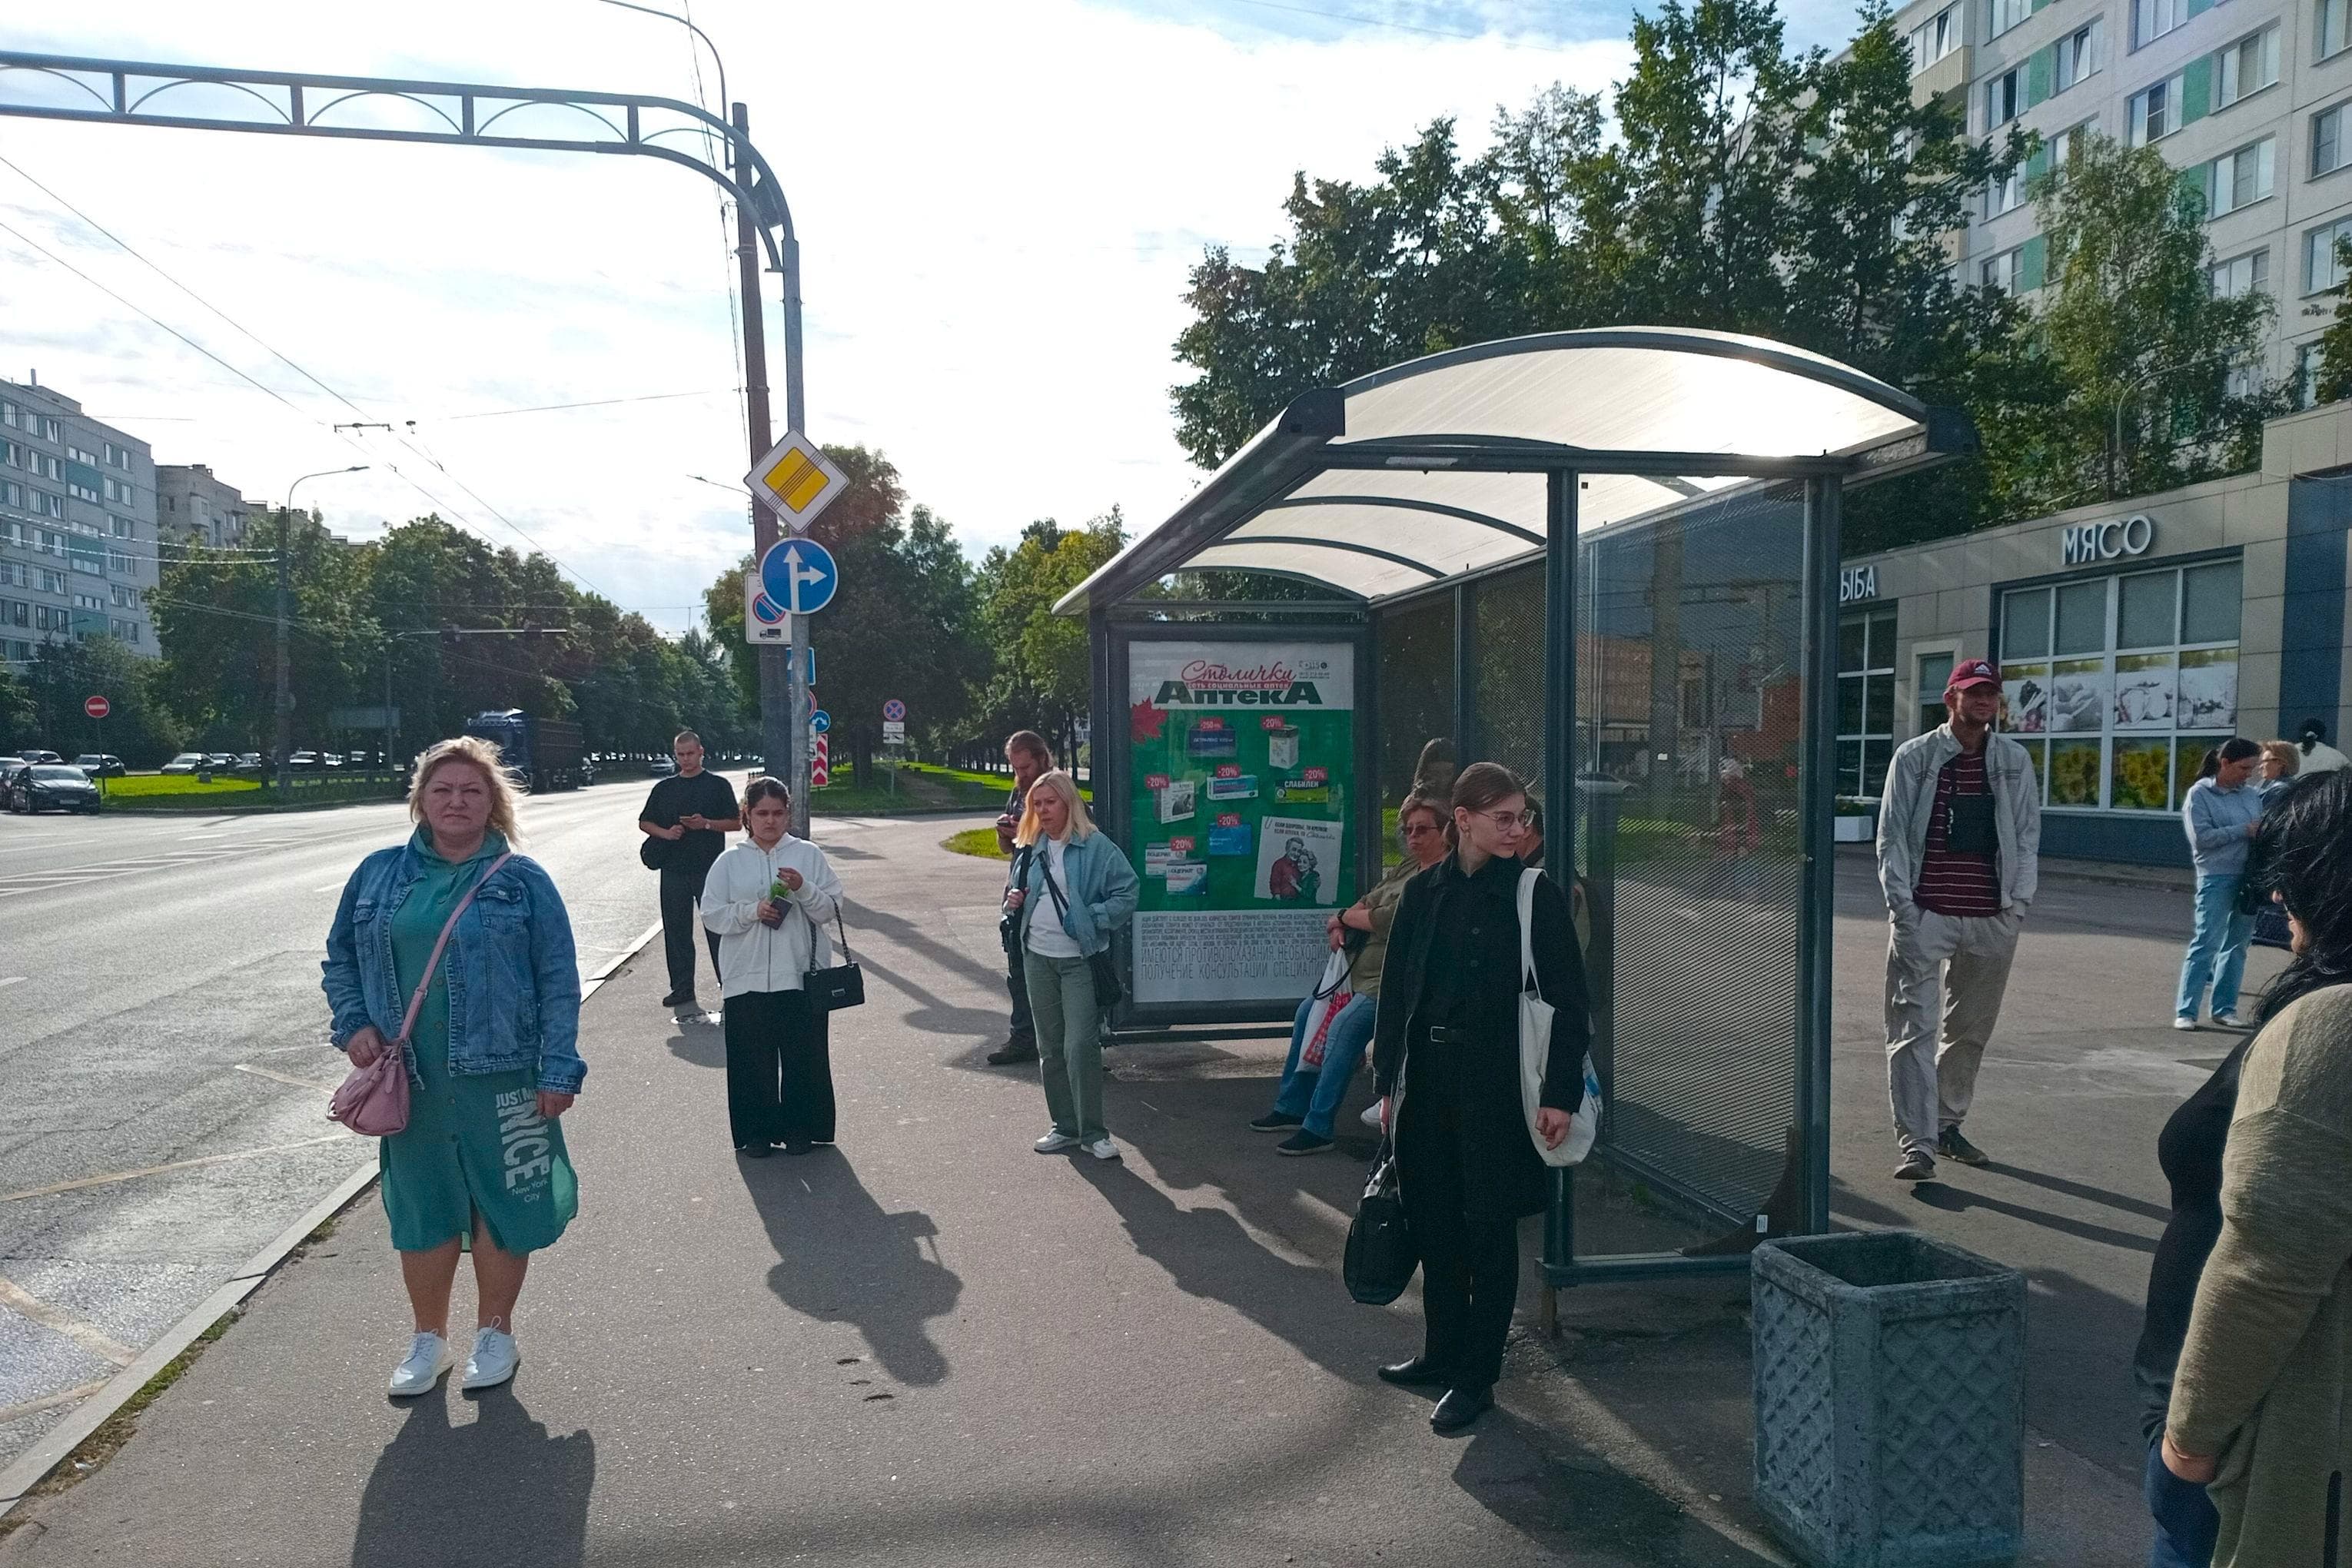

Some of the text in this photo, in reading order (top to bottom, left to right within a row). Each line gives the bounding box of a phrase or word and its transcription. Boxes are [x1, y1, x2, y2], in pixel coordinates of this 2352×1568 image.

[2061, 514, 2152, 565] МЯСО
[1839, 565, 1875, 602] ЫБА
[1181, 659, 1297, 681] Столички
[1263, 717, 1282, 728] -20%
[1218, 766, 1237, 777] -20%
[1305, 769, 1324, 779] -20%
[1147, 776, 1167, 786] -20%
[1219, 815, 1238, 826] -20%
[1172, 838, 1192, 849] -20%
[1141, 946, 1183, 963] ИМЕЮТСЯ
[1141, 963, 1194, 980] ПОЛУЧЕНИЕ
[1199, 961, 1267, 979] КОНСУЛЬТАЦИИ
[496, 1090, 521, 1108] JUST
[512, 1179, 548, 1196] New York
[523, 1192, 541, 1204] City
